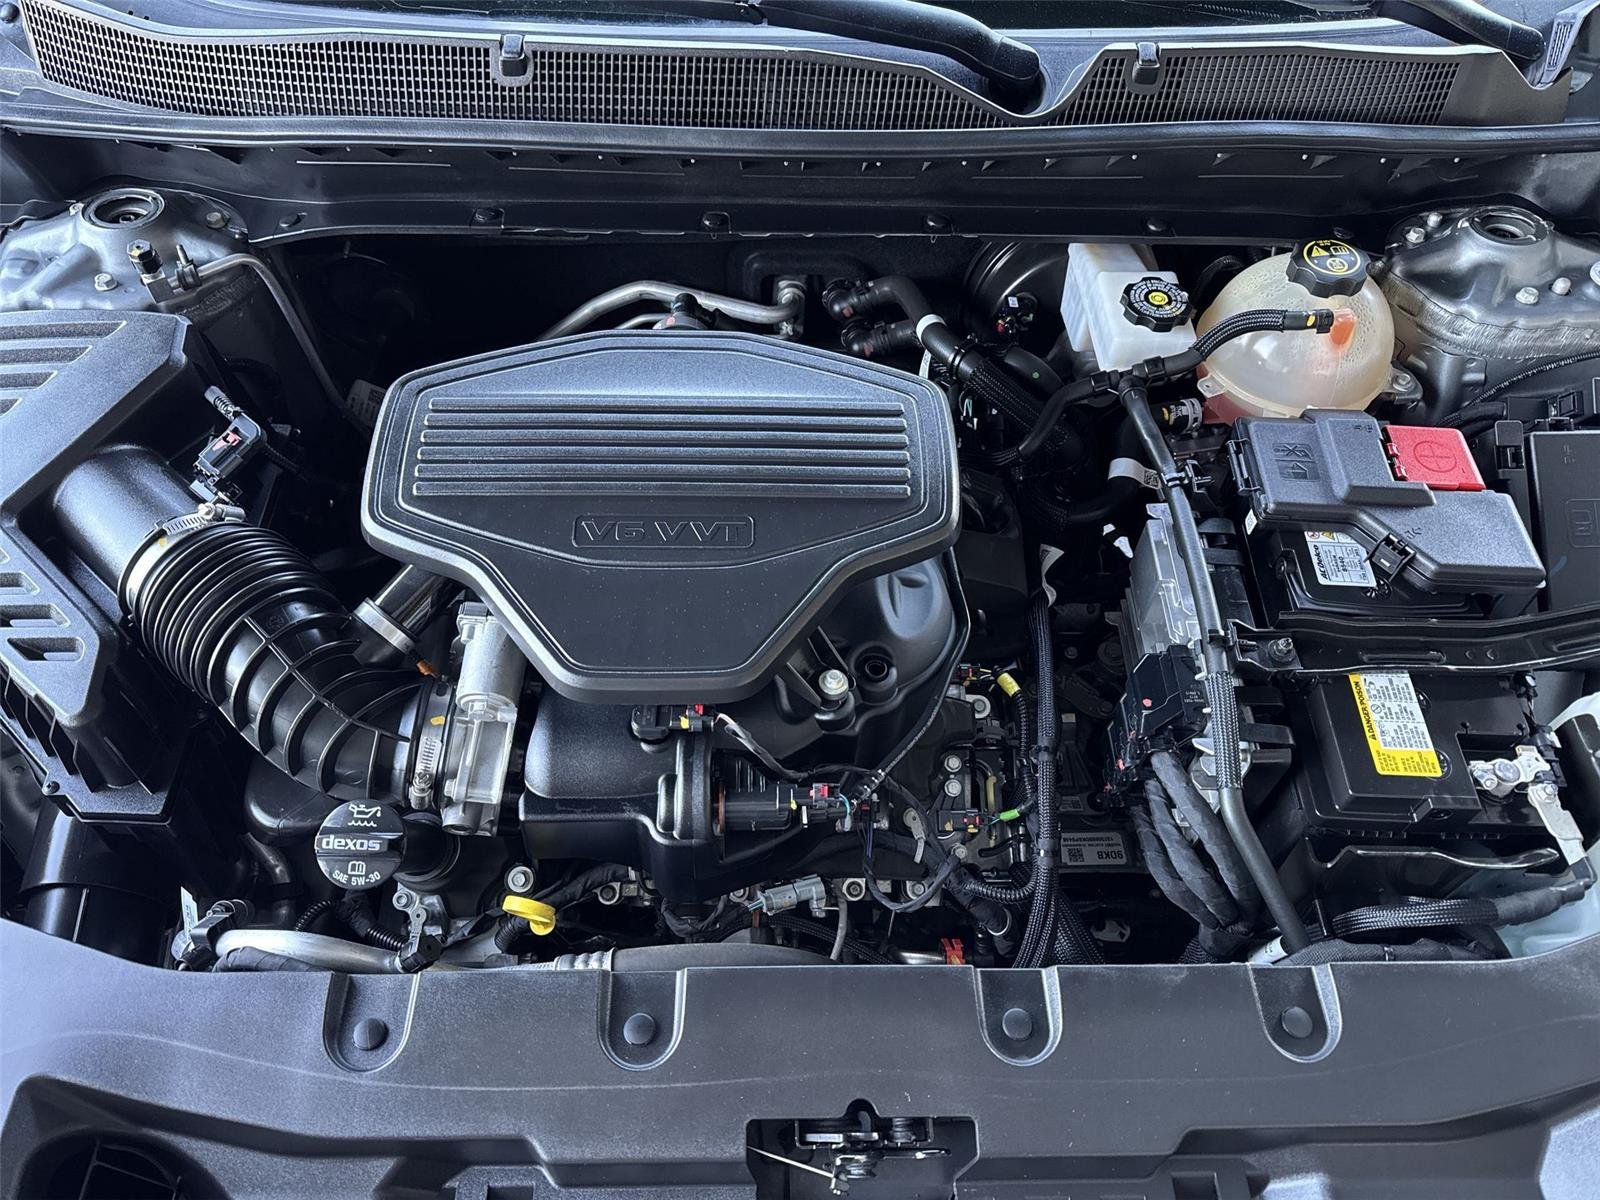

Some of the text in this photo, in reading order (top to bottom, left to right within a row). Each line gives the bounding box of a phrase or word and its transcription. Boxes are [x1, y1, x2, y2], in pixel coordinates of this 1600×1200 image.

[581, 520, 748, 542] V6 VVT
[1353, 680, 1376, 735] DANGER POISON
[321, 834, 383, 851] dexos
[332, 869, 381, 886] SAE 5W-30
